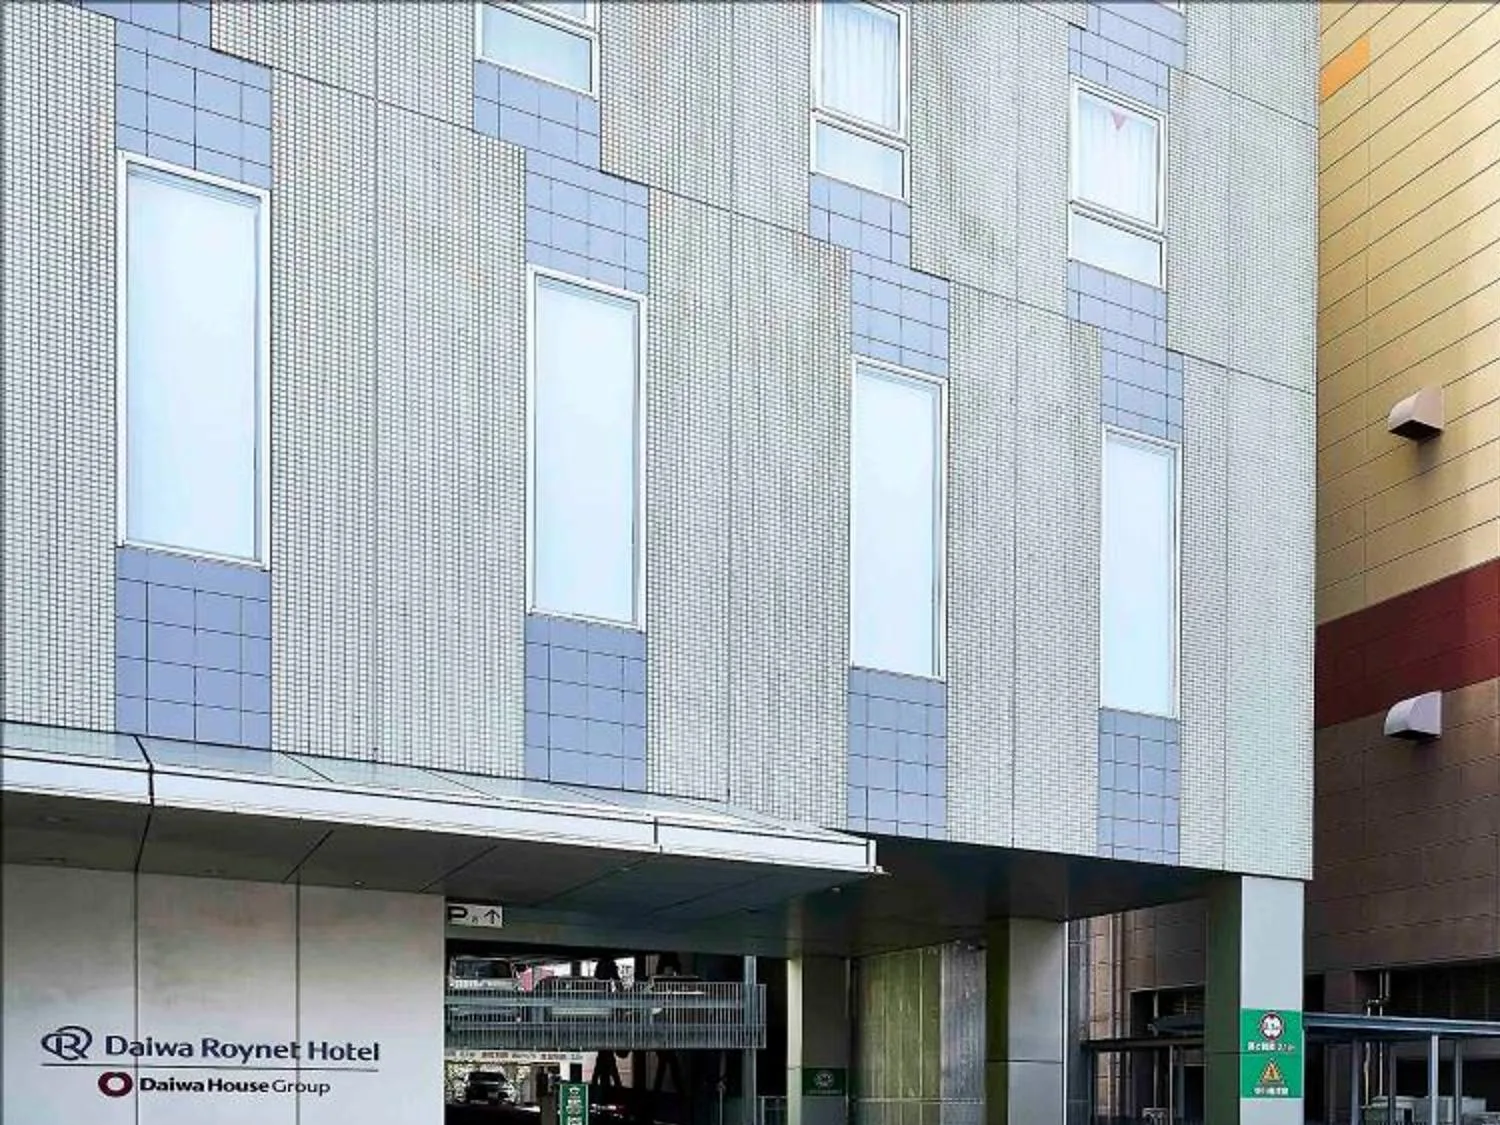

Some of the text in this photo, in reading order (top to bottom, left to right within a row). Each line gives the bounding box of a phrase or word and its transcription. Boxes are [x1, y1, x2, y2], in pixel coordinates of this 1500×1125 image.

[105, 1035, 379, 1064] Daiwa Roynet Hotel
[140, 1077, 331, 1096] Daiwa House Group
